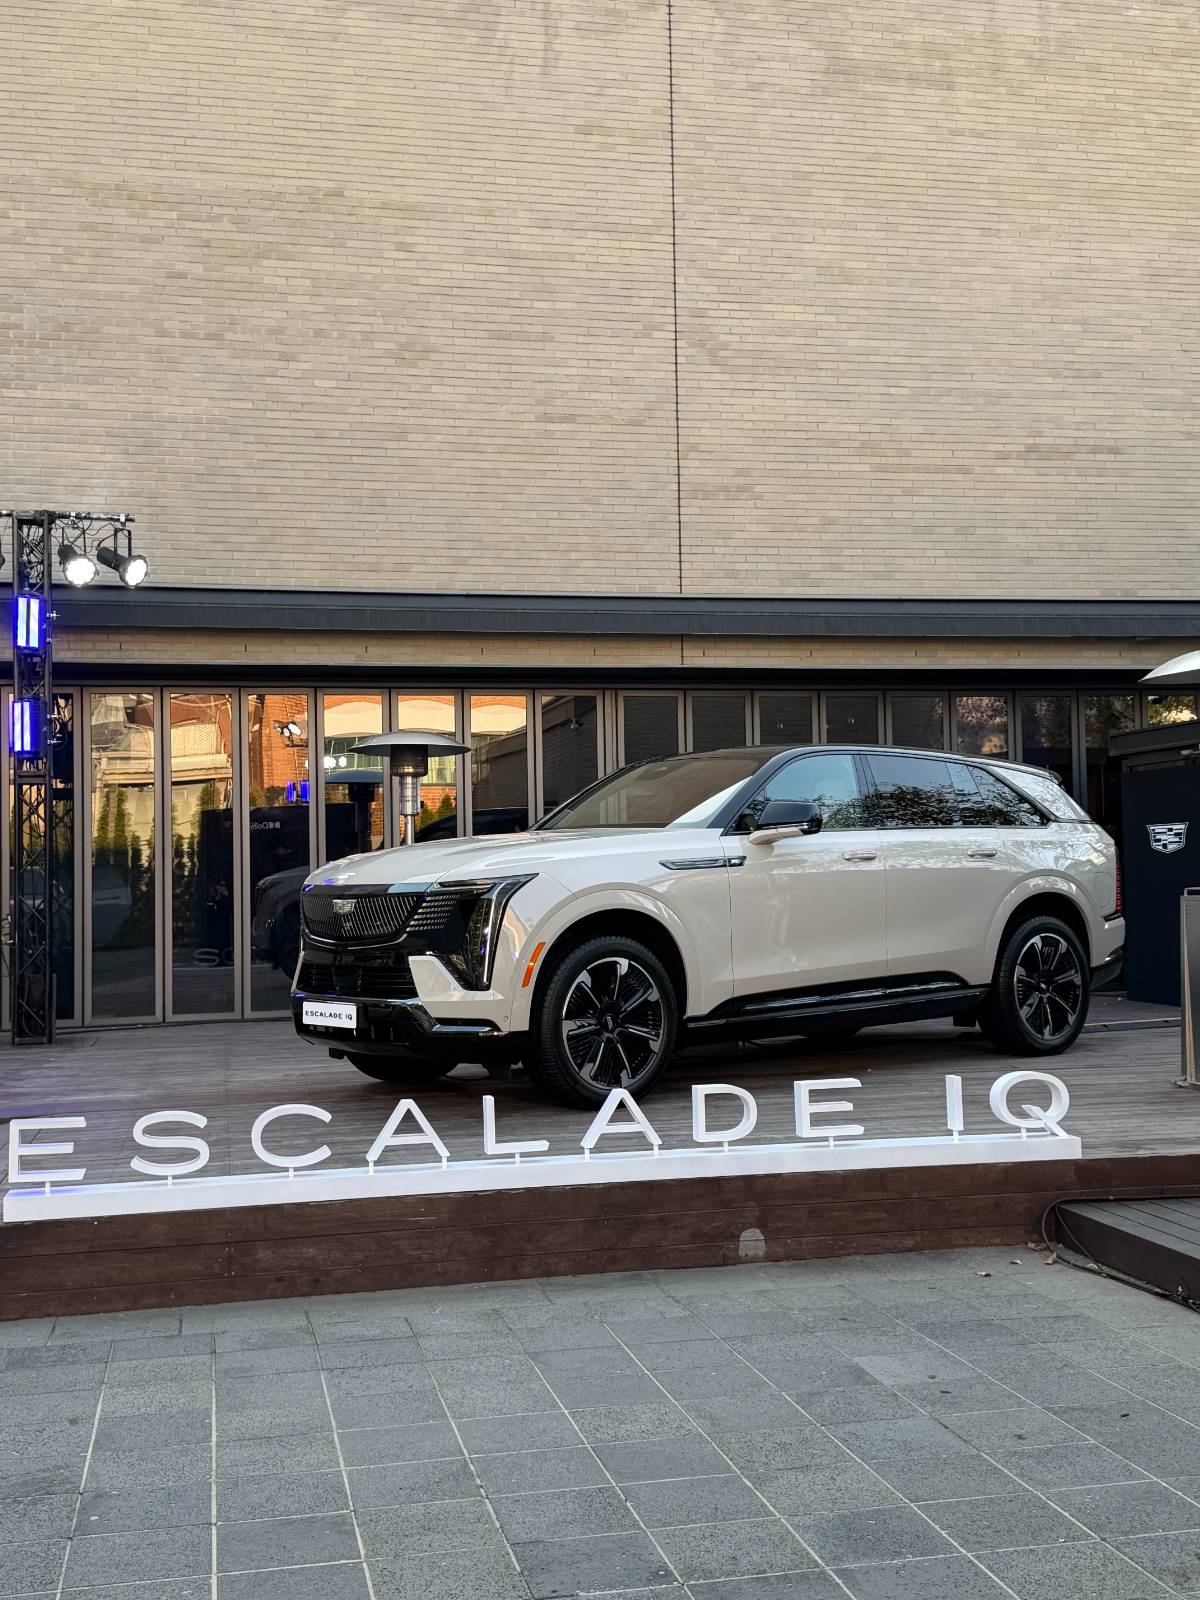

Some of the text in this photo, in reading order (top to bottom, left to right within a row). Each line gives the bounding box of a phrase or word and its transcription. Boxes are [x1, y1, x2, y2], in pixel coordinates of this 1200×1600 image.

[305, 1010, 342, 1019] ESCALADE
[8, 1071, 1070, 1184] ESCALADE IQ
